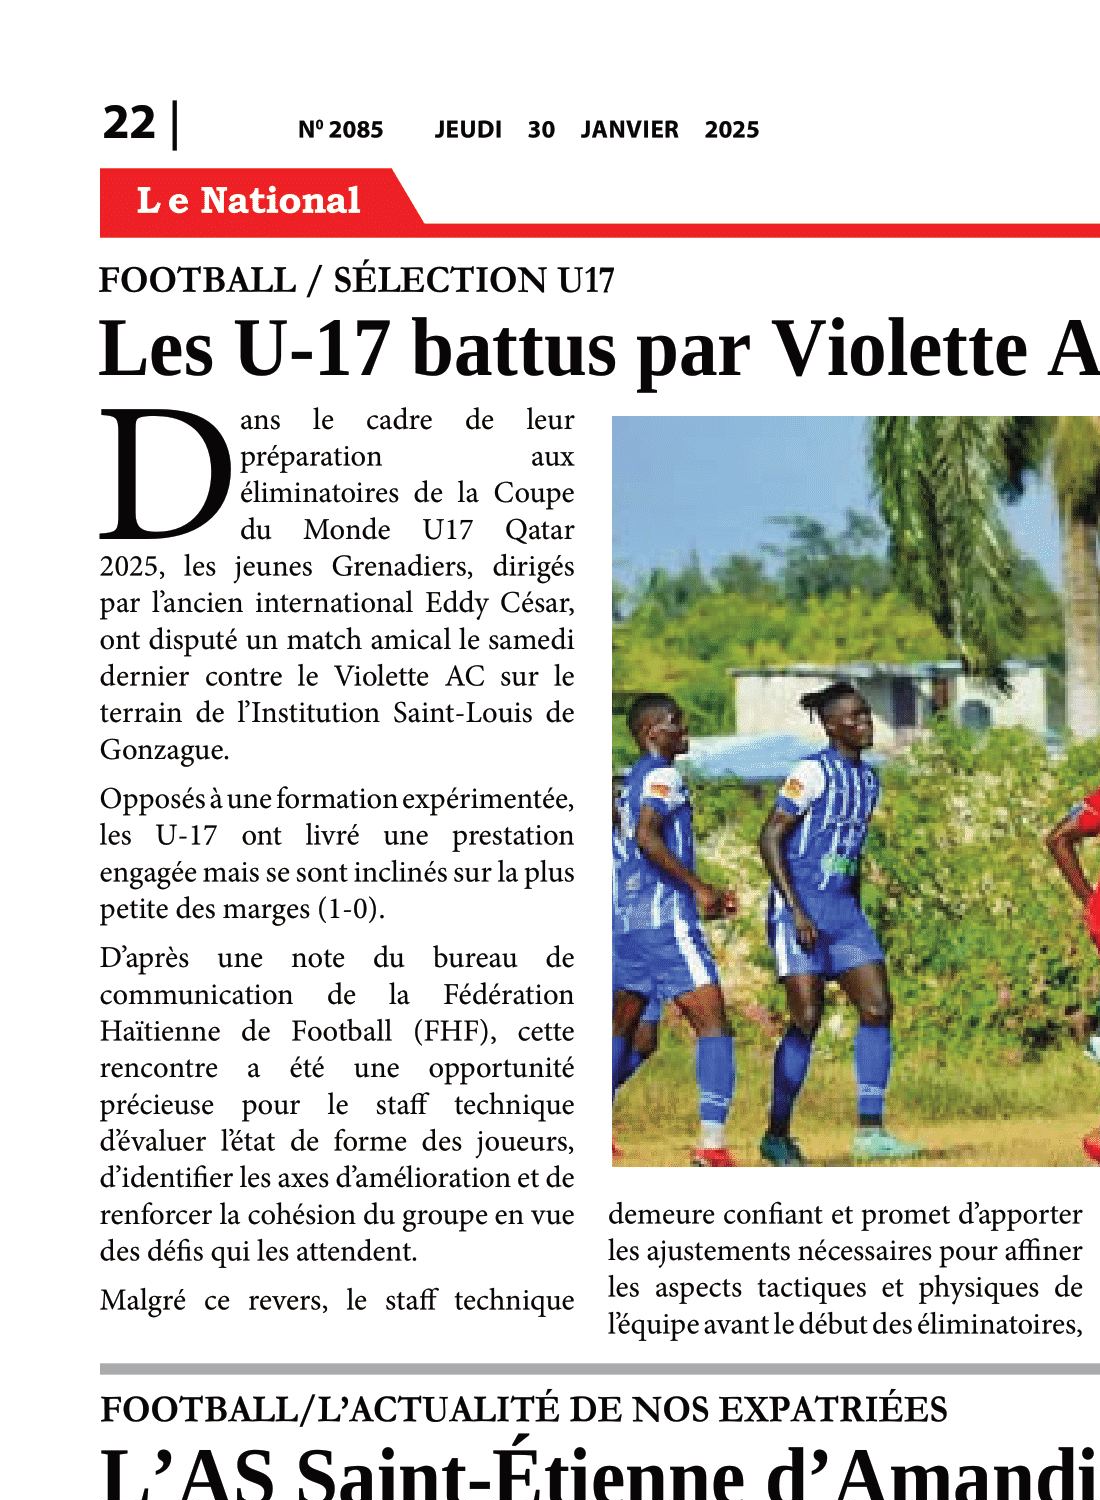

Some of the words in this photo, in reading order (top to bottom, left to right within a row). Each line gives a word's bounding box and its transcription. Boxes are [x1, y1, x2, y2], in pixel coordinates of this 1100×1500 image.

[103, 104, 155, 139] 22
[328, 120, 384, 139] 2085
[434, 119, 502, 139] JEUDI
[527, 120, 556, 139] 30
[580, 119, 679, 139] JANVIER
[704, 120, 760, 139] 2025
[201, 185, 361, 214] National
[98, 265, 297, 293] FOOTBALL
[306, 264, 323, 298] /
[334, 258, 548, 294] SÉLECTION
[557, 266, 615, 294] U17
[98, 319, 213, 377] Les
[234, 319, 391, 377] U-17
[411, 316, 616, 377] battus
[636, 334, 751, 394] par
[771, 316, 1027, 377] Violette
[240, 414, 281, 430] ans
[312, 406, 334, 430] le
[366, 406, 433, 431] cadre
[465, 406, 494, 430] de
[526, 406, 576, 430] leur
[100, 555, 165, 580] 2025,
[184, 553, 216, 577] les
[233, 555, 313, 584] jeunes
[332, 553, 473, 580] Grenadiers,
[493, 553, 575, 584] dirigés
[99, 597, 141, 621] par
[151, 589, 244, 613] l’ancien
[255, 589, 414, 613] international
[425, 589, 490, 621] Eddy
[500, 590, 575, 616] César,
[99, 897, 169, 927] petite
[176, 895, 216, 919] des
[222, 903, 310, 927] marges
[318, 895, 385, 924] (1-0).
[99, 1201, 213, 1226] renforcer
[219, 1201, 241, 1225] la
[248, 1201, 357, 1226] cohésion
[363, 1201, 396, 1225] du
[402, 1209, 488, 1233] groupe
[494, 1209, 525, 1225] en
[530, 1209, 575, 1225] vue
[607, 1237, 640, 1261] les
[647, 1239, 791, 1269] ajustements
[797, 1238, 932, 1262] nécessaires
[939, 1245, 999, 1269] pour
[1005, 1237, 1084, 1261] affiner
[569, 1395, 623, 1423] DE
[631, 1395, 709, 1423] NOS
[718, 1388, 948, 1423] EXPATRIÉES
